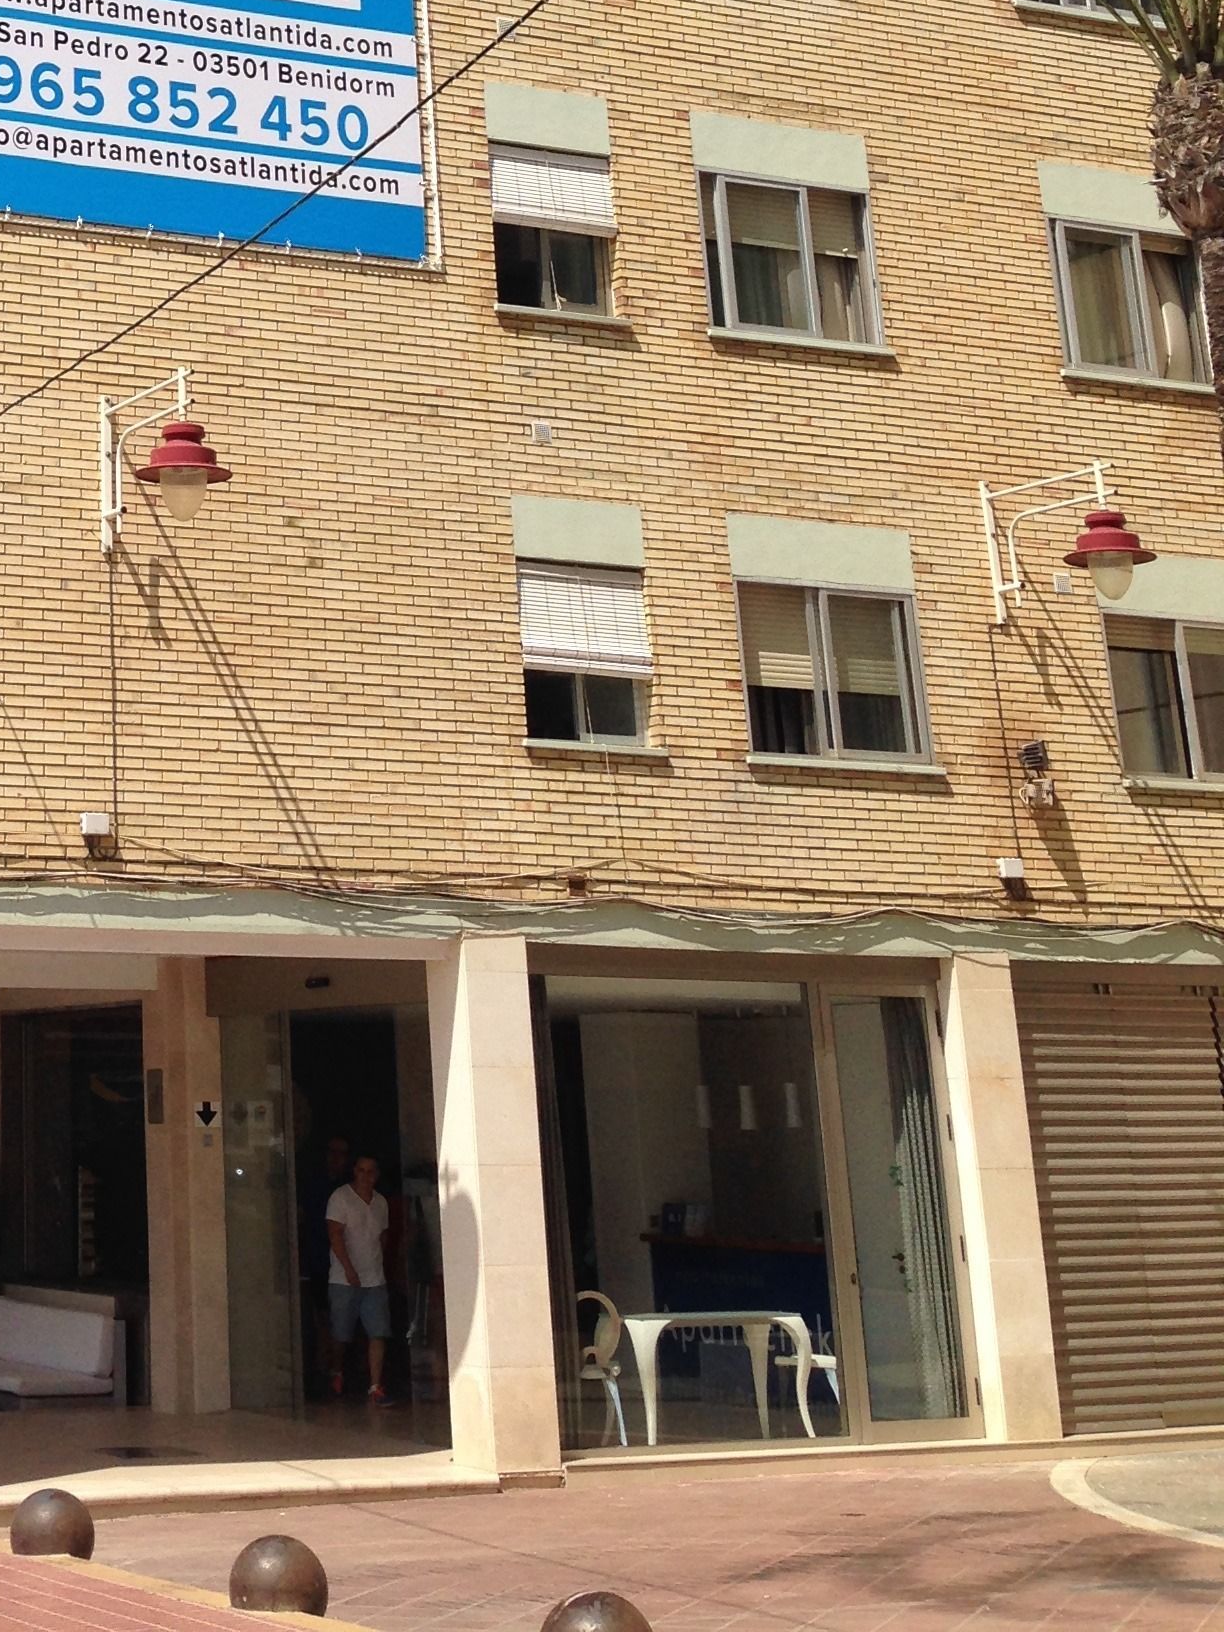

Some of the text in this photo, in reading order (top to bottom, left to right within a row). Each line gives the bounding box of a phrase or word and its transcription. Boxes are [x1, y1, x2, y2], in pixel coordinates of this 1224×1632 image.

[53, 30, 129, 61] Pedro
[137, 43, 169, 68] 22
[192, 50, 270, 82] 03501
[278, 62, 396, 99] Benidorm
[128, 75, 239, 135] 852
[260, 95, 369, 151] 450
